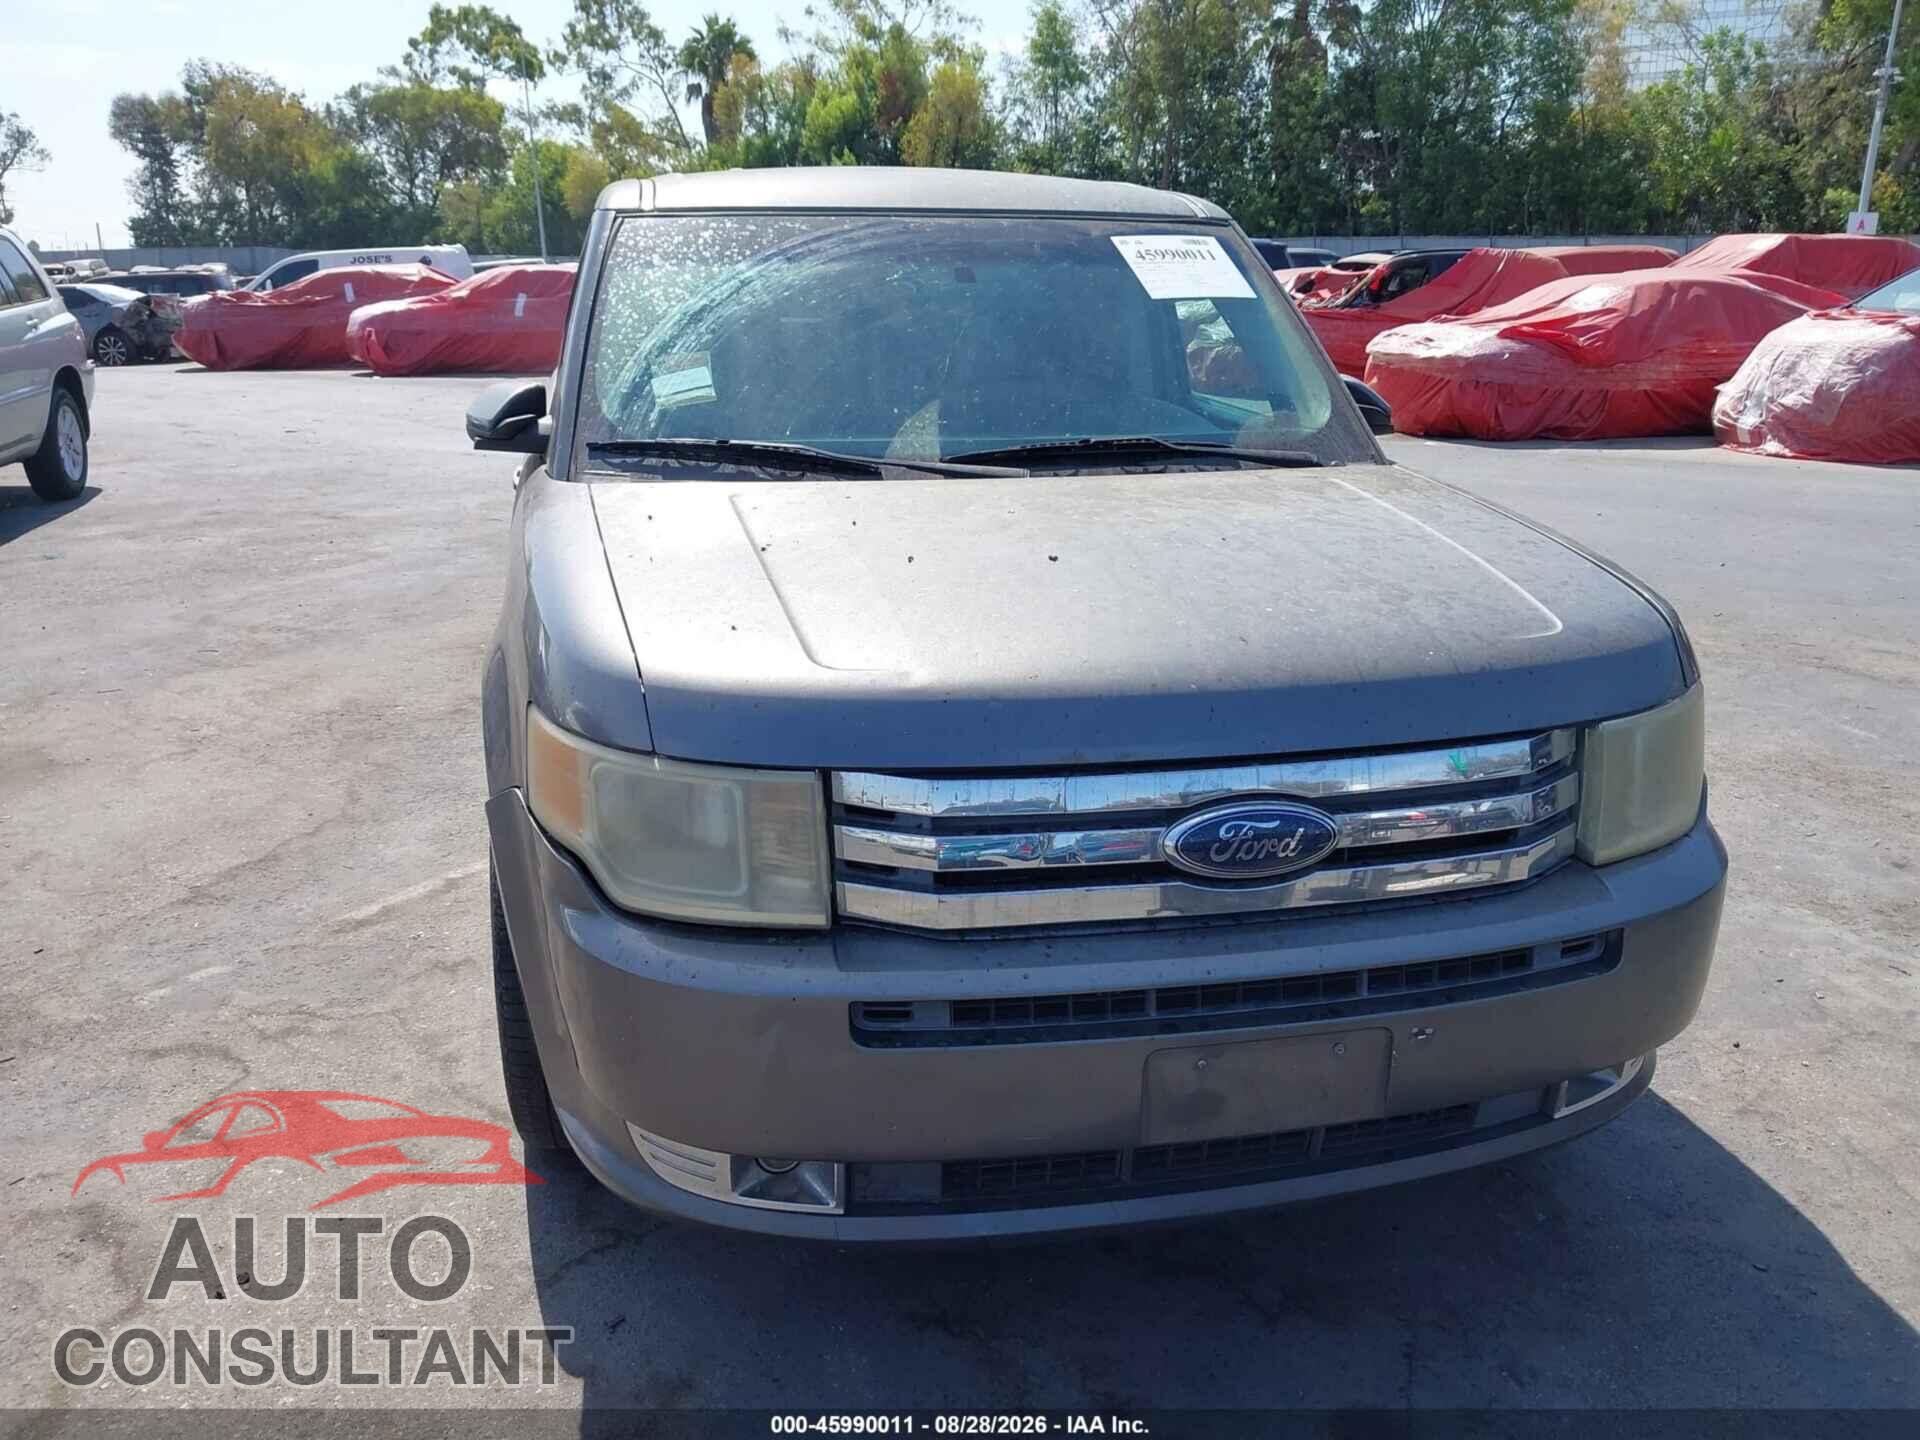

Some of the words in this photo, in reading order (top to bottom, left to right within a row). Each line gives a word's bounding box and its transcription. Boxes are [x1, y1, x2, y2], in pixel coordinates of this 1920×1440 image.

[350, 255, 392, 264] JOSE'S
[1135, 248, 1217, 261] 45990011
[1209, 820, 1304, 863] Ford
